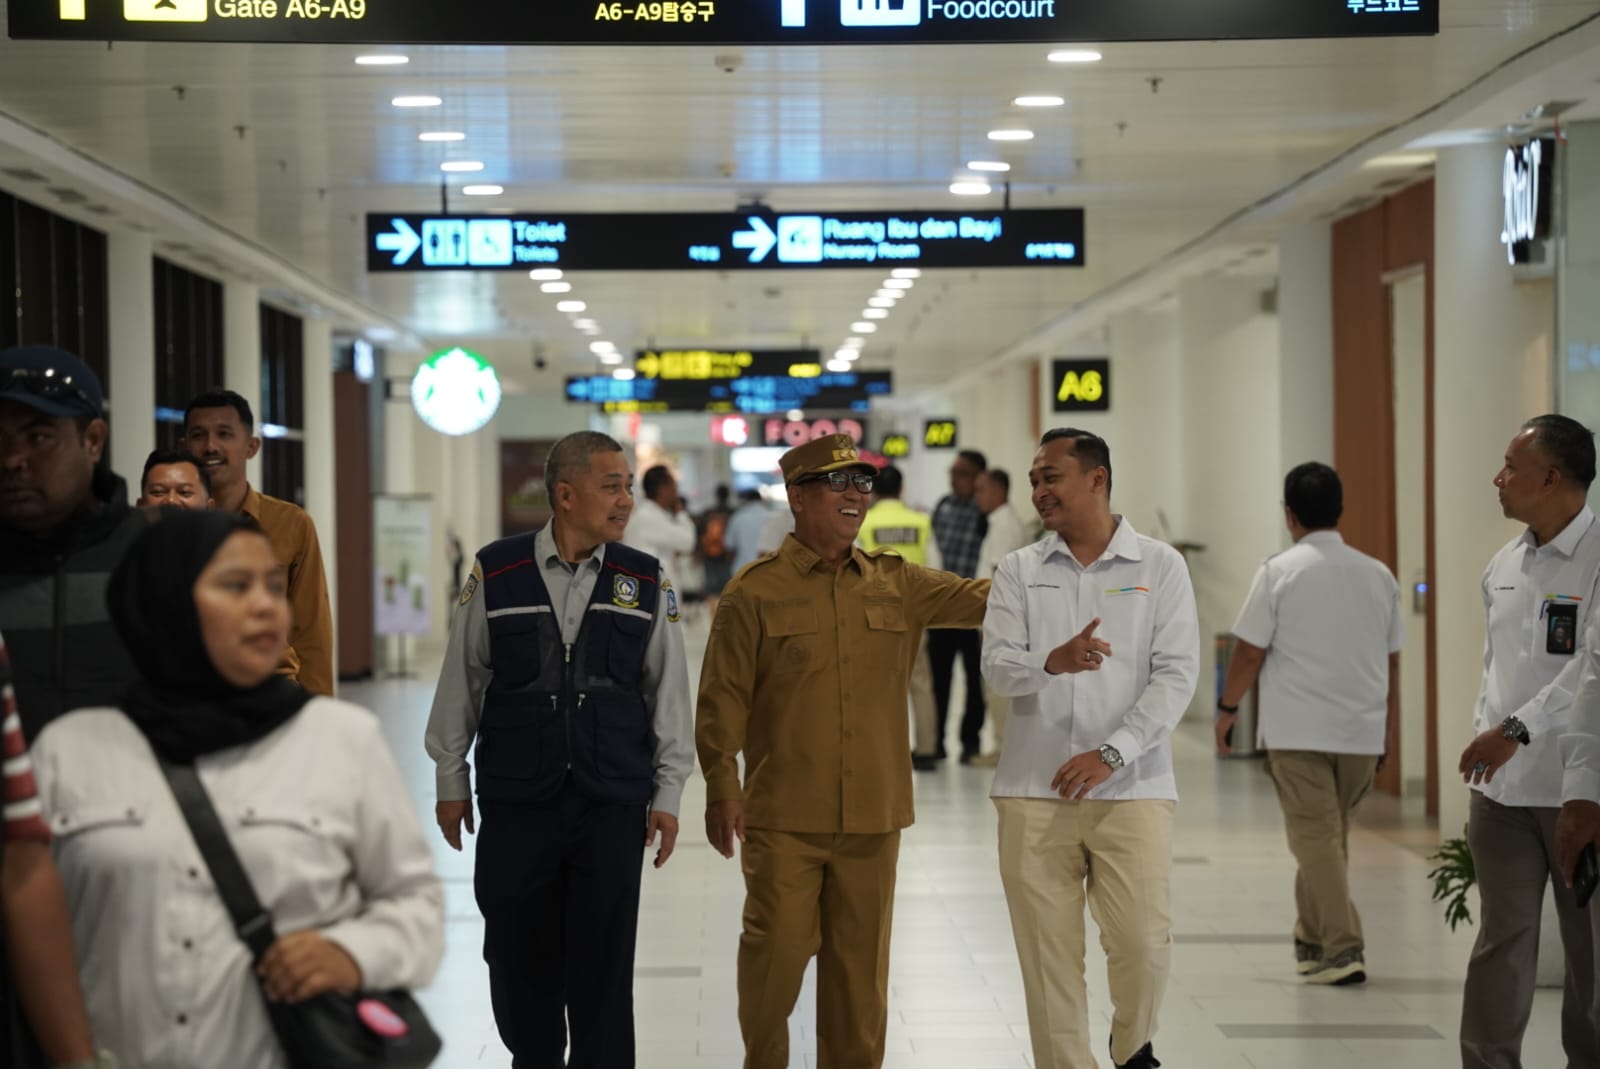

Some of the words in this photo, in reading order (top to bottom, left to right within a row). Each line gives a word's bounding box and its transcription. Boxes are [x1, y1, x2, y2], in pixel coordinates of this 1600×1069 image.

[214, 0, 278, 18] Gate
[285, 0, 366, 19] A6-A9
[927, 0, 1055, 19] Foodcourt
[514, 221, 566, 242] Toilet
[920, 218, 957, 239] dan
[1057, 370, 1103, 402] A6
